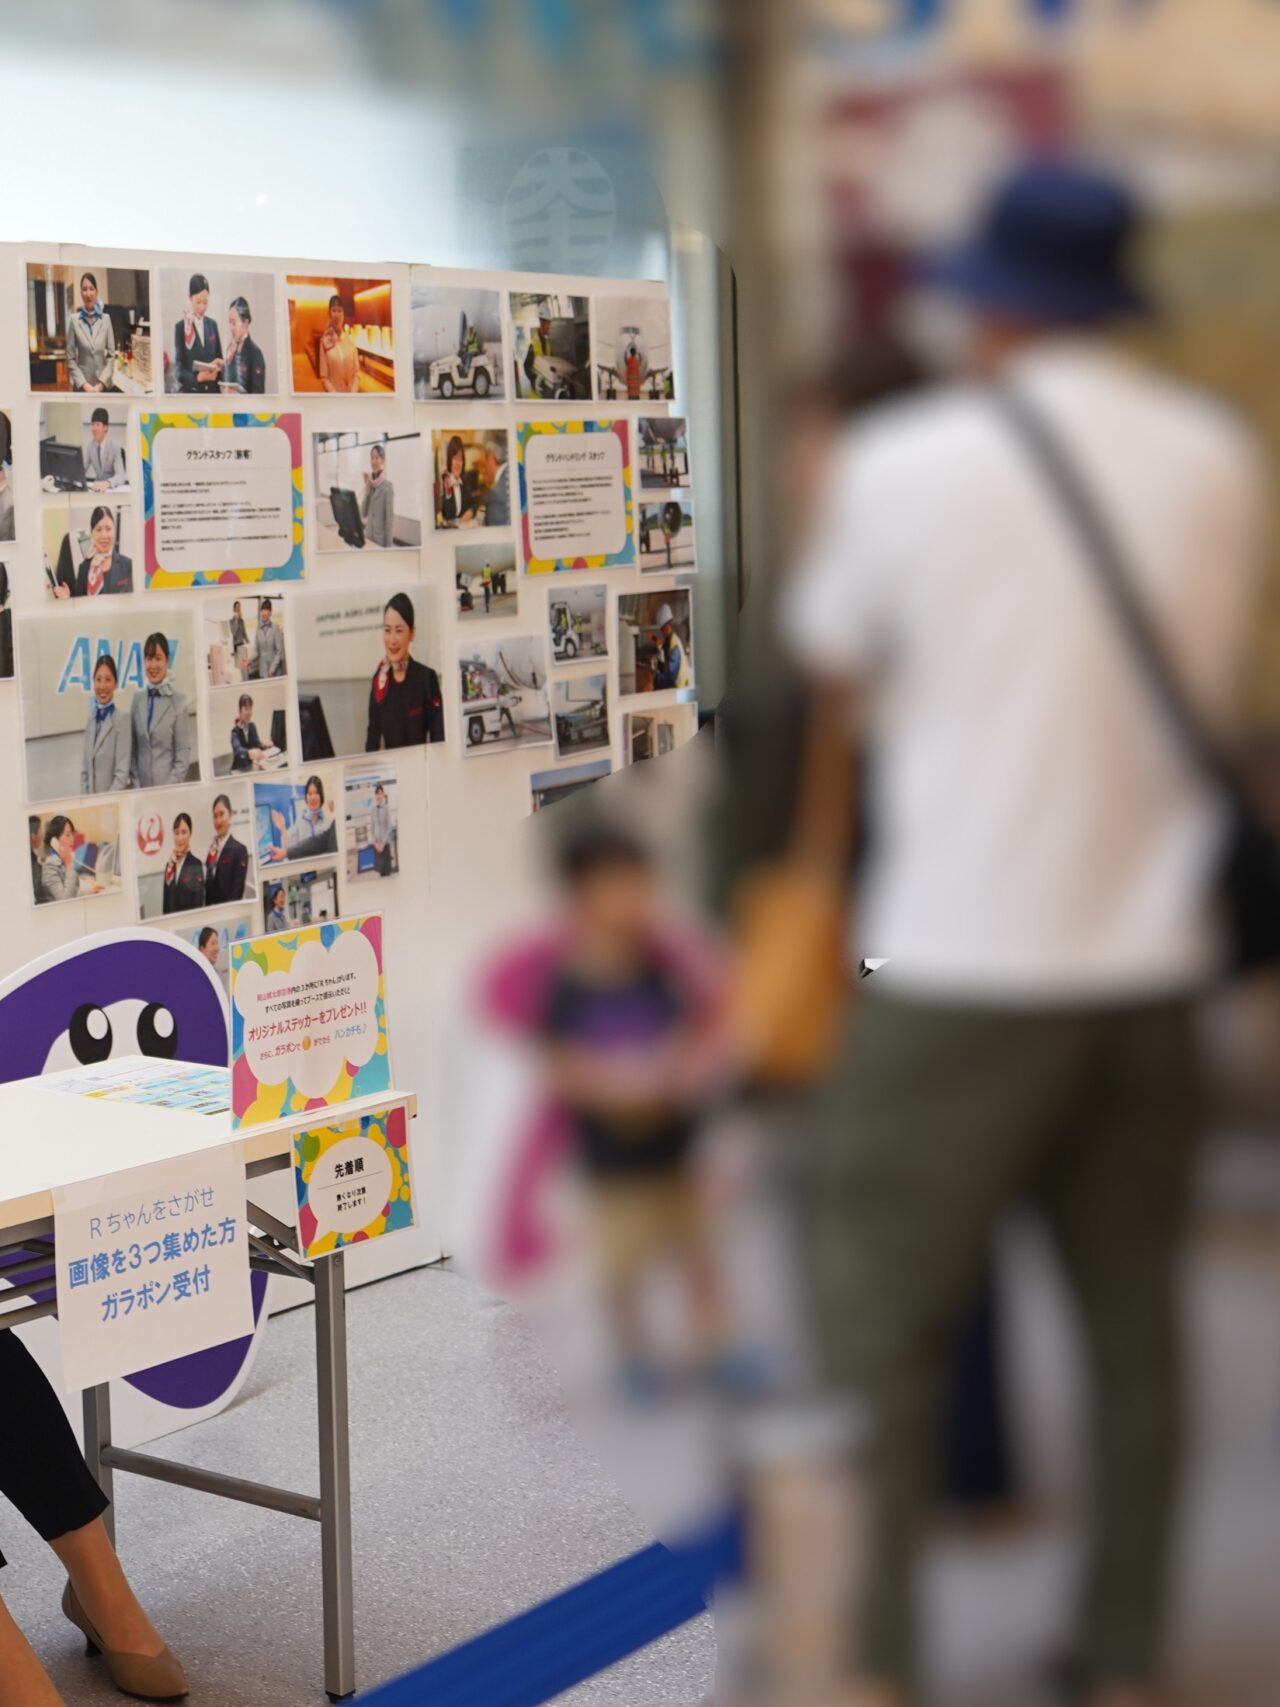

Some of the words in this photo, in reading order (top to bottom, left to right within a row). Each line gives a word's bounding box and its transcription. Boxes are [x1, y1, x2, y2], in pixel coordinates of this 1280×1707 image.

[334, 1157, 365, 1179] 先着順
[68, 1216, 237, 1289] 画像を3つ集めた方
[101, 1264, 211, 1323] ガラポン受付
